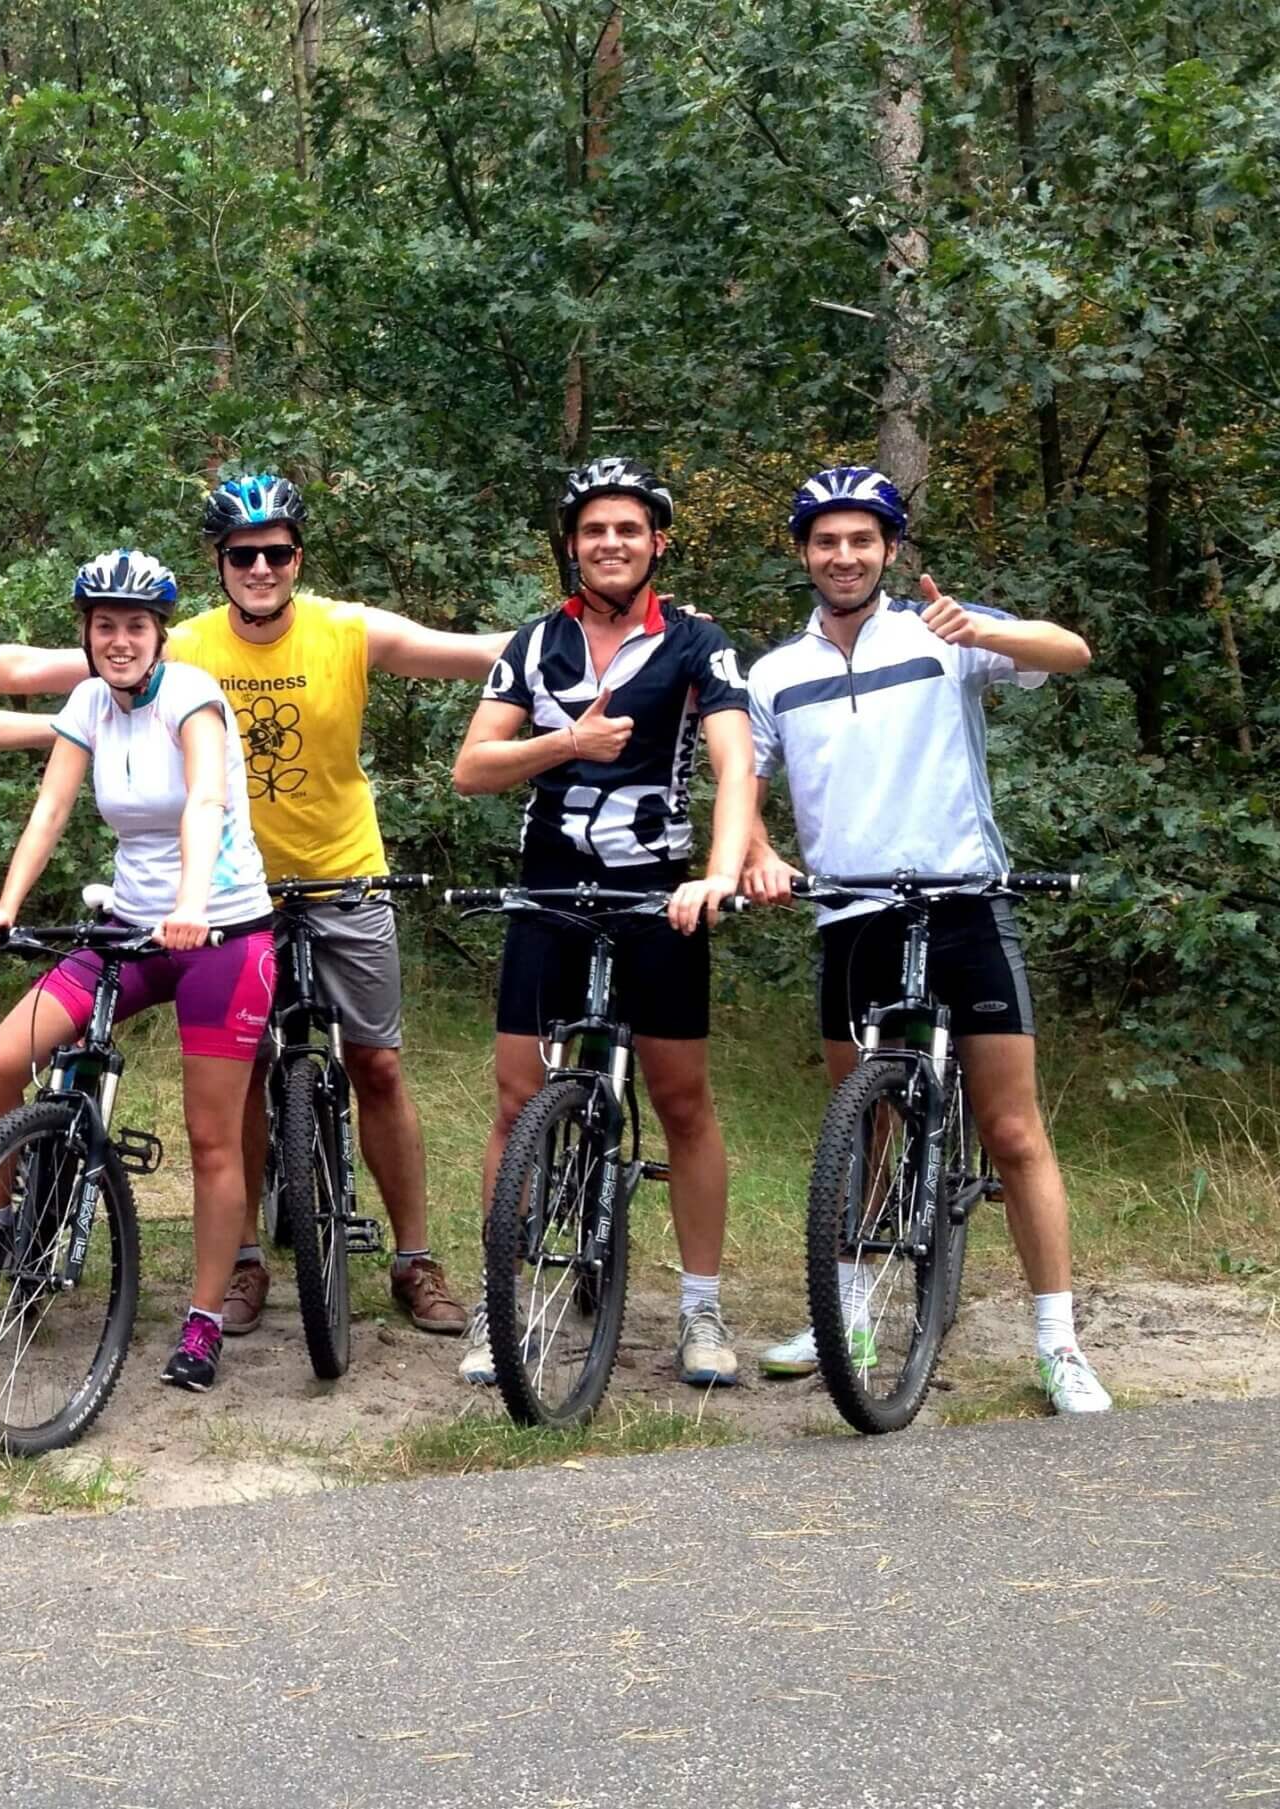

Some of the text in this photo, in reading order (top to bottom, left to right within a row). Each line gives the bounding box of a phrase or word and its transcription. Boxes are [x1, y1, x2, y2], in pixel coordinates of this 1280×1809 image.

[219, 675, 308, 692] niceness
[70, 1182, 100, 1265] BLAZE
[594, 1161, 619, 1243] BLAZE
